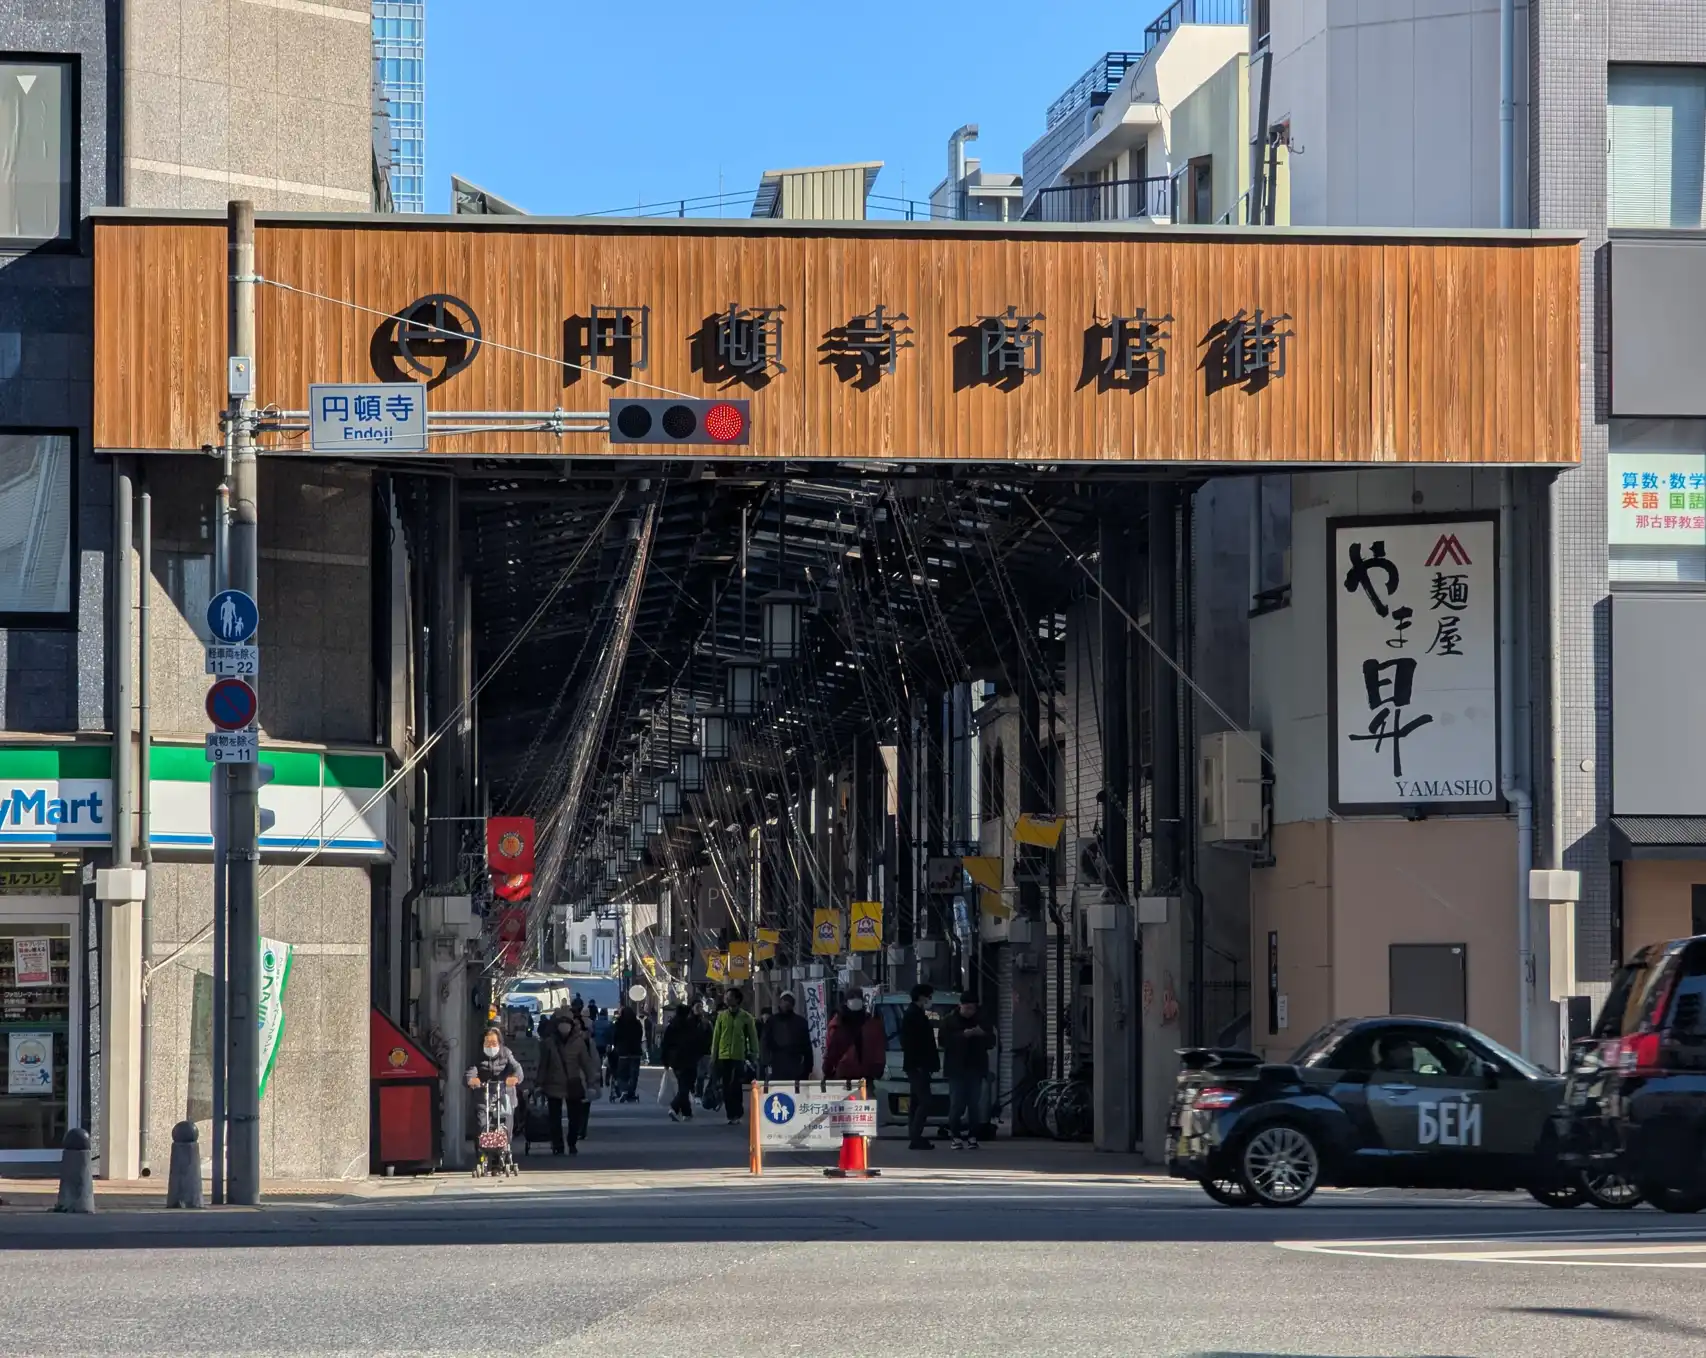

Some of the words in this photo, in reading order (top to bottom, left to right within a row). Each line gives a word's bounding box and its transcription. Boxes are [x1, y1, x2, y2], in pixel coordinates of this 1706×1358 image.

[590, 302, 1295, 379] 円頓寺商店街
[322, 394, 414, 422] 円頓寺
[343, 427, 393, 444] Endoji
[1622, 472, 1705, 489] 算数・数学
[1622, 492, 1659, 509] 英語
[1669, 493, 1705, 510] 国語
[1636, 514, 1705, 529] 那古野教室
[209, 648, 256, 660] 軽車両を除く
[210, 661, 253, 673] 11-22
[209, 736, 256, 747] 貨物を除く
[214, 748, 251, 761] 9-11
[1396, 780, 1493, 797] YAMASHO
[1418, 1092, 1481, 1146] БЕЙ
